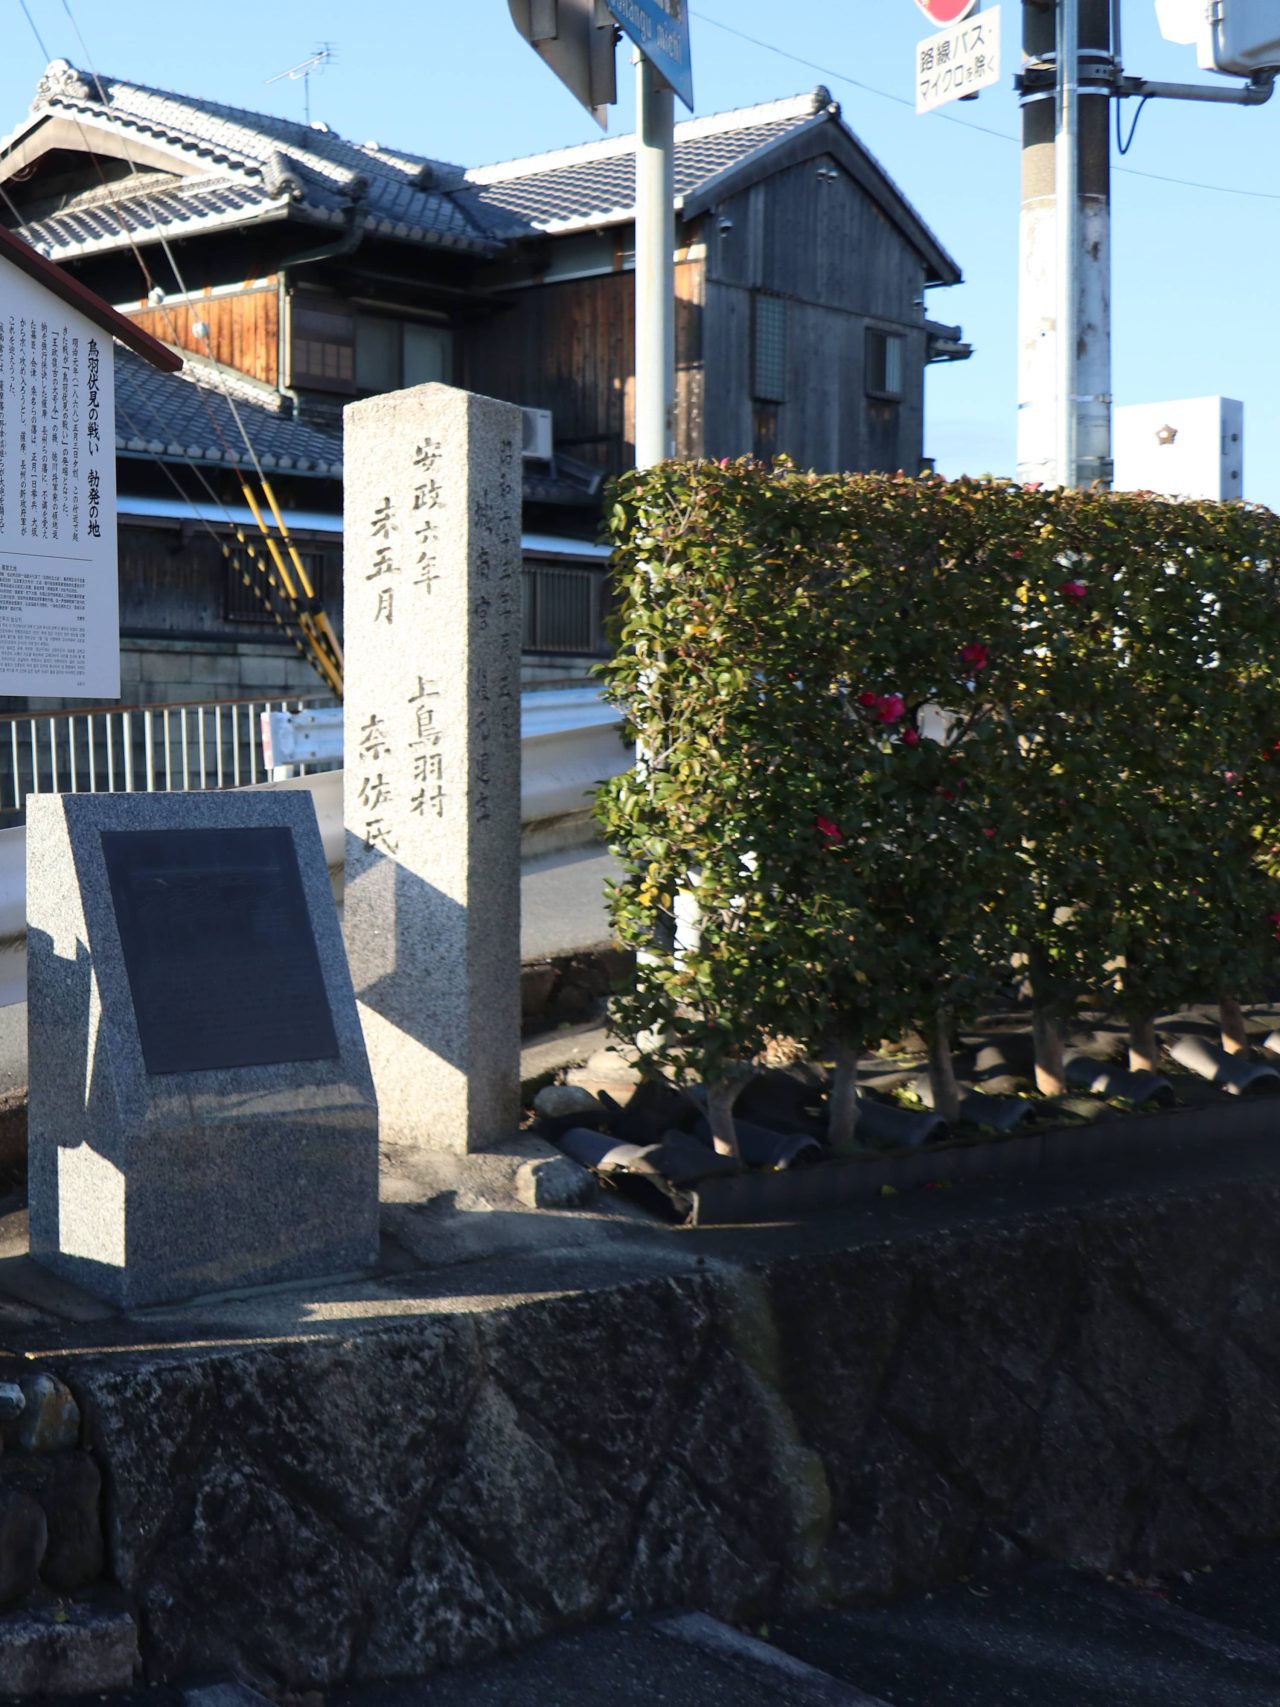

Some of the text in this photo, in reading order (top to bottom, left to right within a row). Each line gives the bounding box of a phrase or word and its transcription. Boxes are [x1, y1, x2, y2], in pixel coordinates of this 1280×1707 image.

[920, 54, 995, 101] マイクロを除く
[86, 338, 102, 539] 鳥羽伏見の戦い 勃発の地
[357, 497, 401, 856] 未五月 奈佐氏
[407, 437, 446, 818] 安政六年 上鳥羽村
